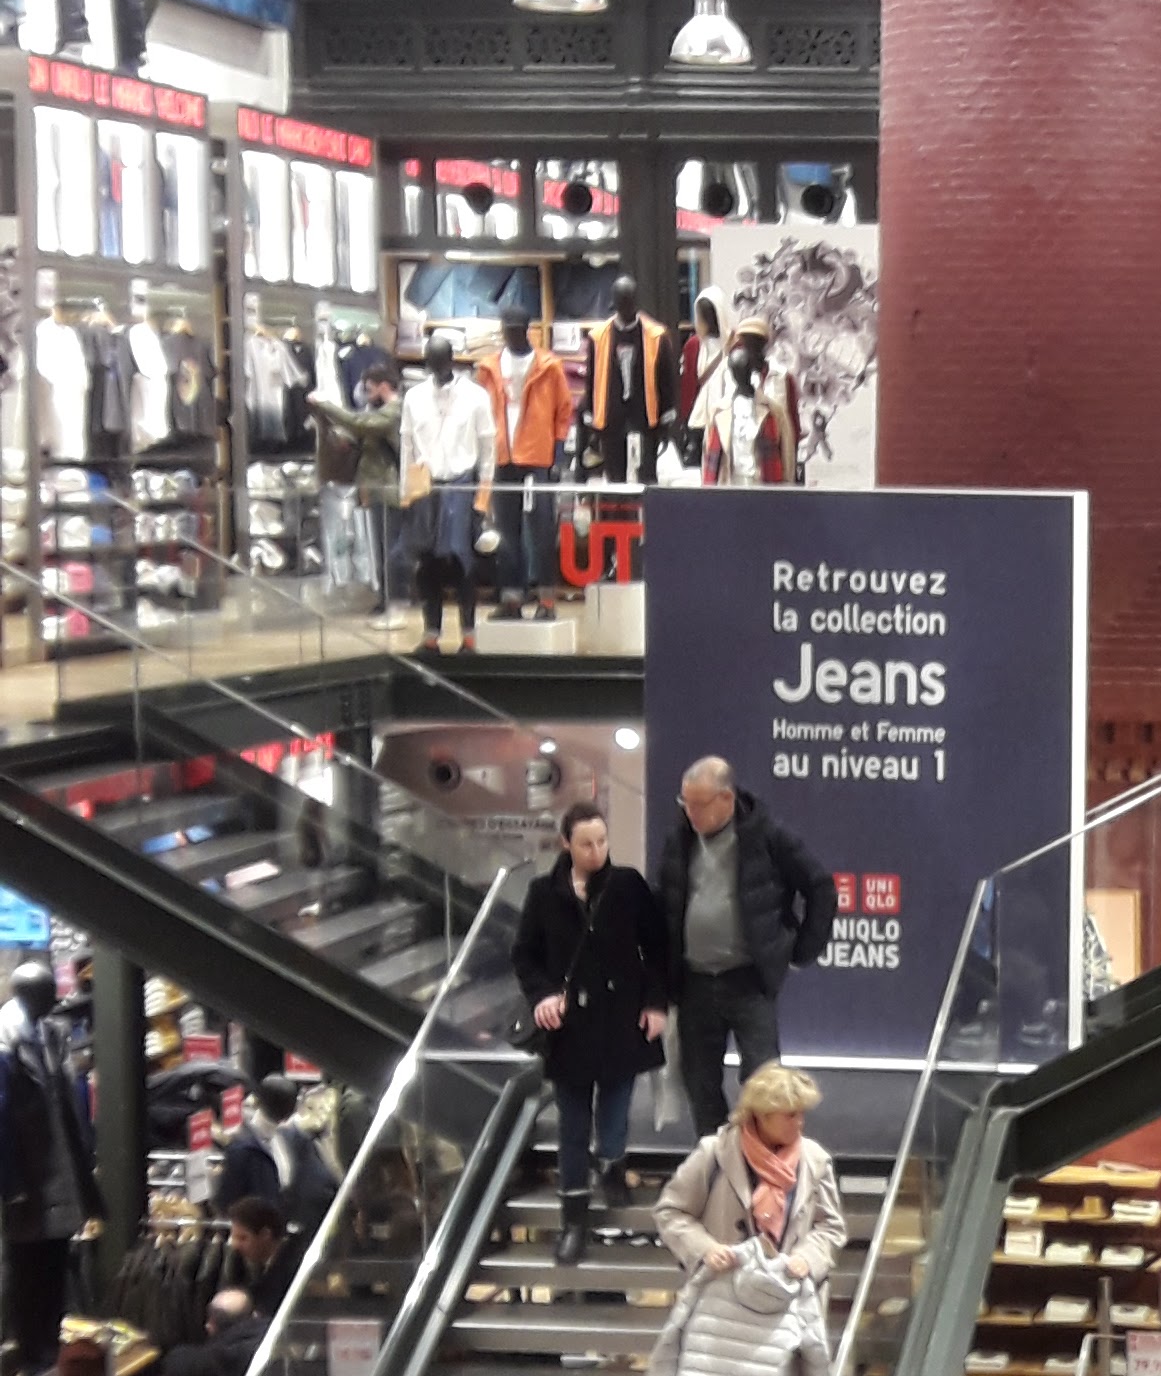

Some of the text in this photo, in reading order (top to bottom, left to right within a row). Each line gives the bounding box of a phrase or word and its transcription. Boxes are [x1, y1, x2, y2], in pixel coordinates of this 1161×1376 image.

[560, 522, 644, 587] UT
[773, 560, 946, 595] Retrouvez
[773, 601, 946, 636] la collection
[773, 642, 946, 706] Jeans
[773, 718, 946, 744] Homme et Femme
[773, 747, 945, 781] au niveau 1
[866, 878, 893, 893] UNI
[866, 894, 896, 911] QLO
[832, 918, 900, 943] NIQLO
[817, 942, 900, 969] JEANS
